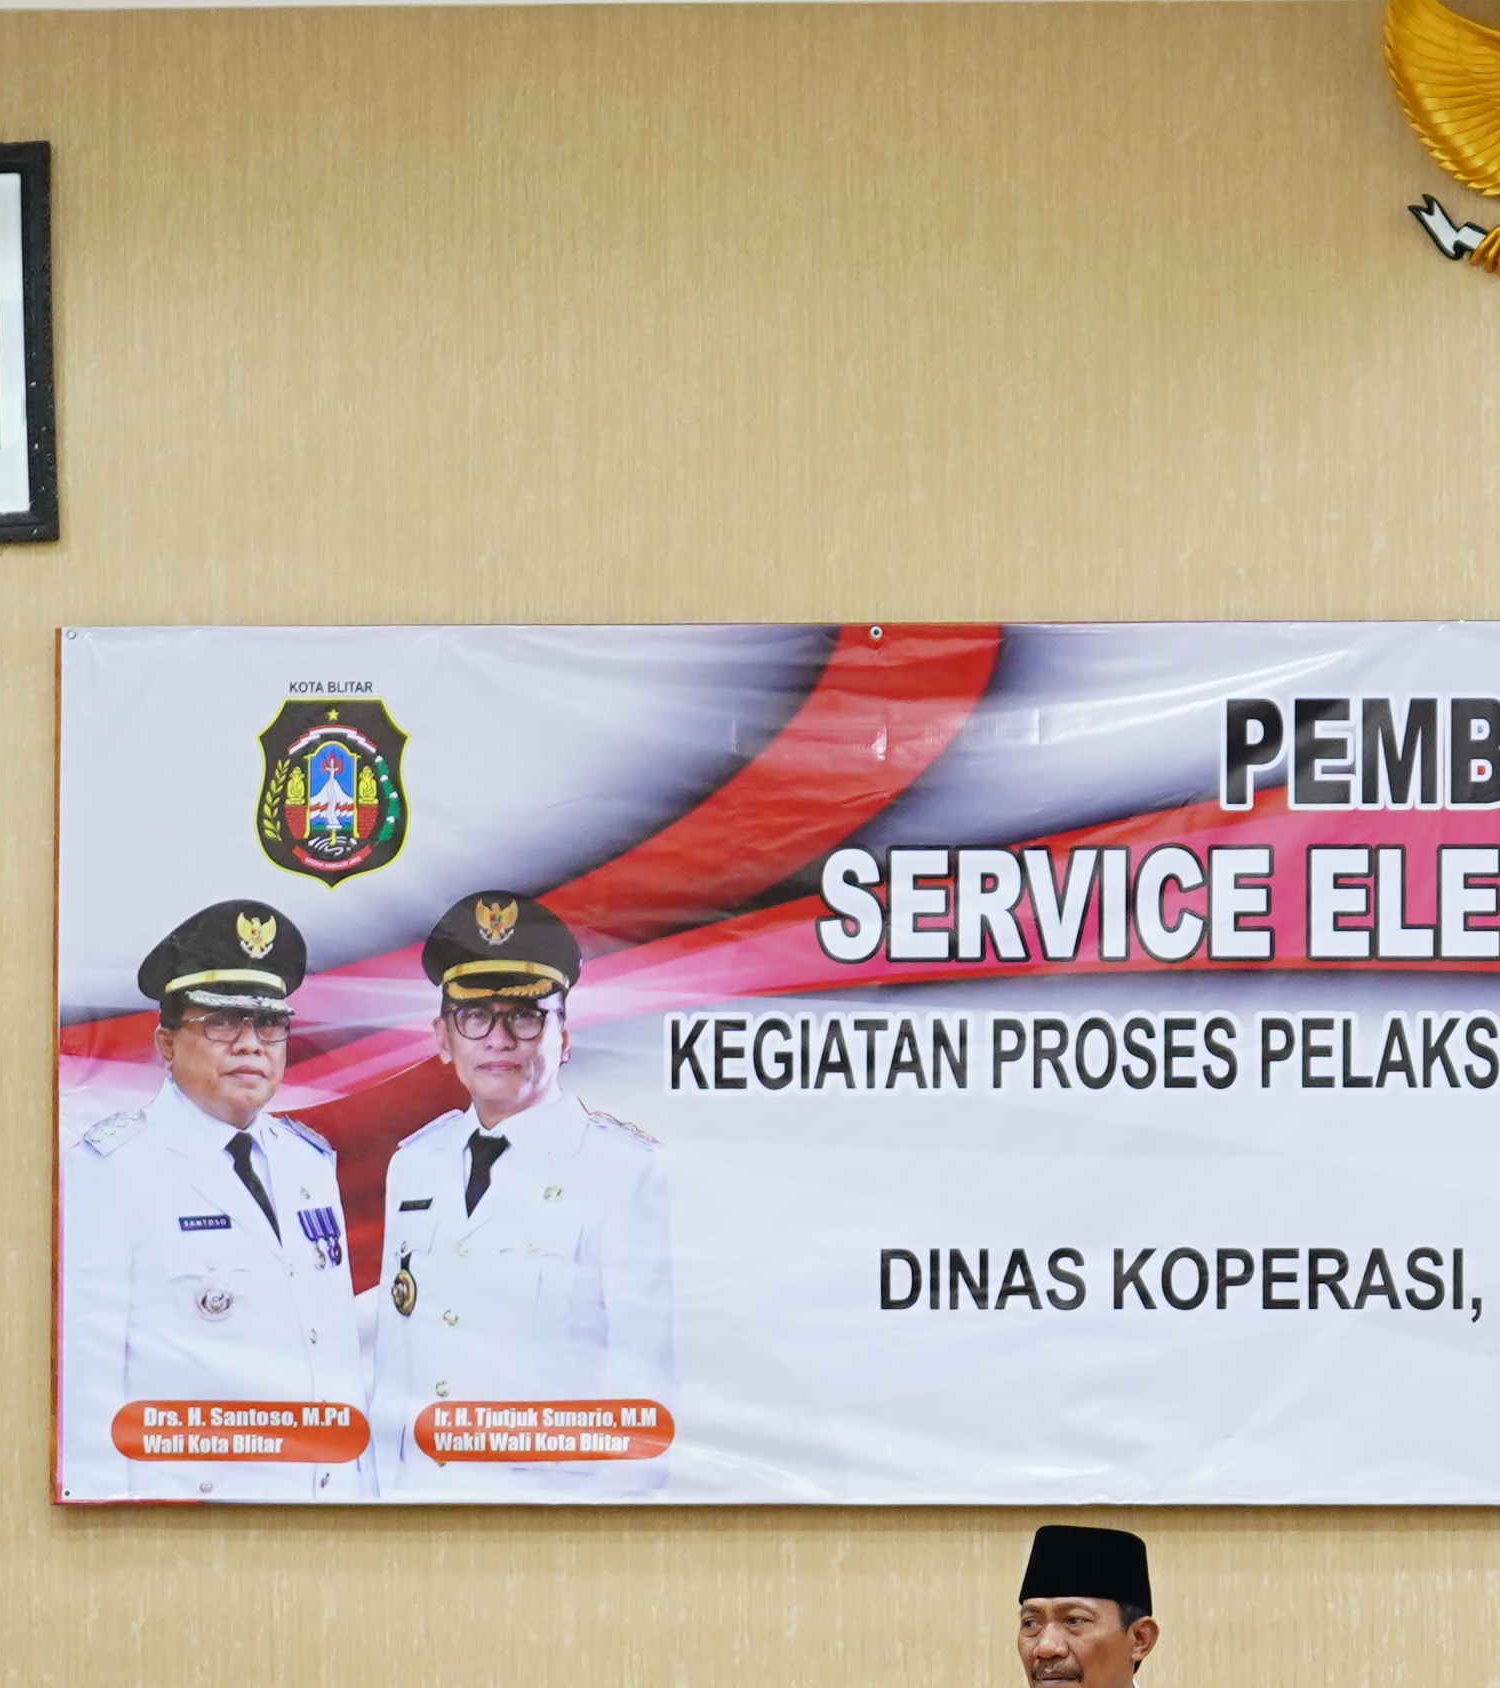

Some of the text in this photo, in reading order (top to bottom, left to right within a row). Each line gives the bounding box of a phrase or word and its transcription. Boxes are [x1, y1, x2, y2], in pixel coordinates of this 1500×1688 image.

[289, 681, 373, 693] KOTA BLITAR
[817, 845, 1274, 964] SERVICE
[669, 1017, 967, 1091] KEGIATAN
[992, 1017, 1238, 1091] PROSES
[881, 1247, 1086, 1312] DINAS
[1113, 1247, 1483, 1323] KOPERASI,
[143, 1407, 350, 1428] Drs. H. Santoso, M.Pd
[434, 1408, 657, 1429] Ir. H. Tjutjuk Sunario, M.M
[143, 1435, 283, 1454] Wali Kota Blitar
[433, 1433, 630, 1451] Wakil Wali Kota Blitar
